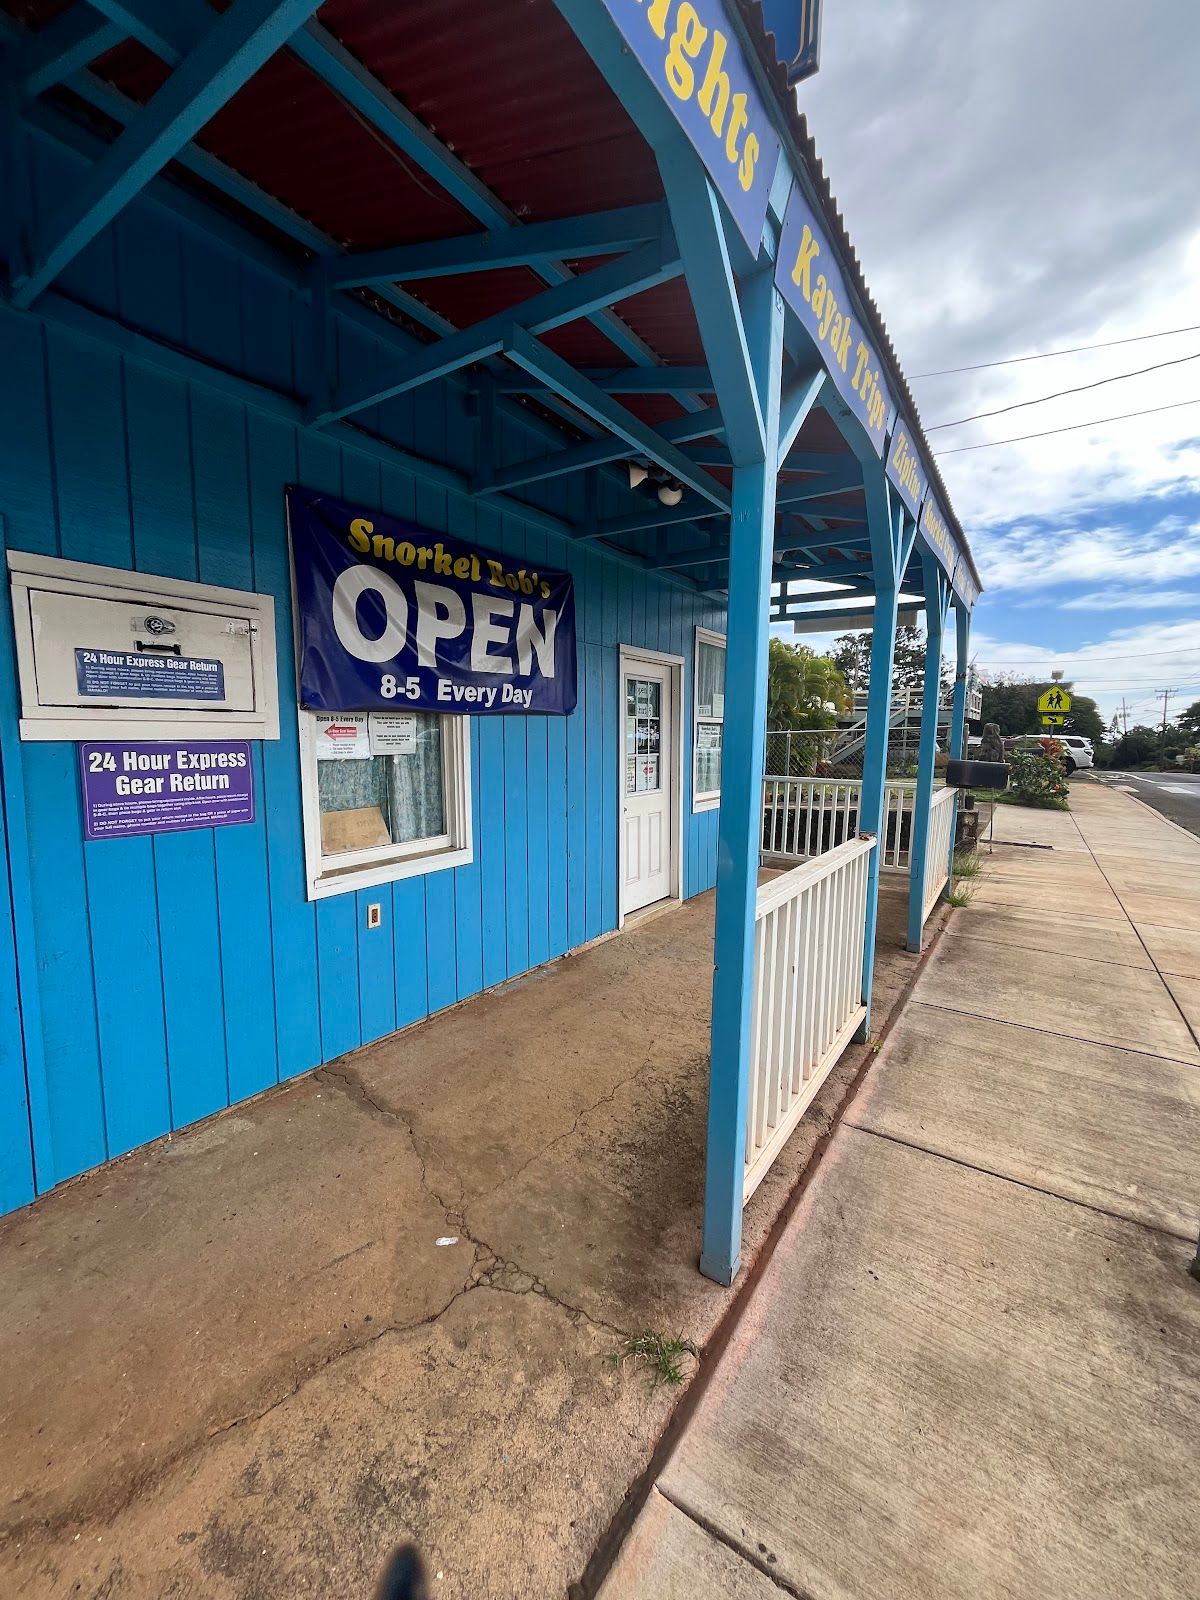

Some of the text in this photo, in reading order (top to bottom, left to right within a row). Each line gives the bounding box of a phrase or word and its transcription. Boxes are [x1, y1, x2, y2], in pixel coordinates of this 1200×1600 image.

[791, 225, 885, 431] Kayak Trips
[892, 431, 921, 503] Zipline
[348, 518, 550, 598] Snorkel Bob's
[332, 564, 557, 678] OPEN
[83, 652, 218, 672] 24 Hour Express Gear Return
[380, 674, 533, 708] 8-5 Every Day
[88, 750, 247, 773] 24 Hour Express
[115, 773, 230, 795] Gear Return
